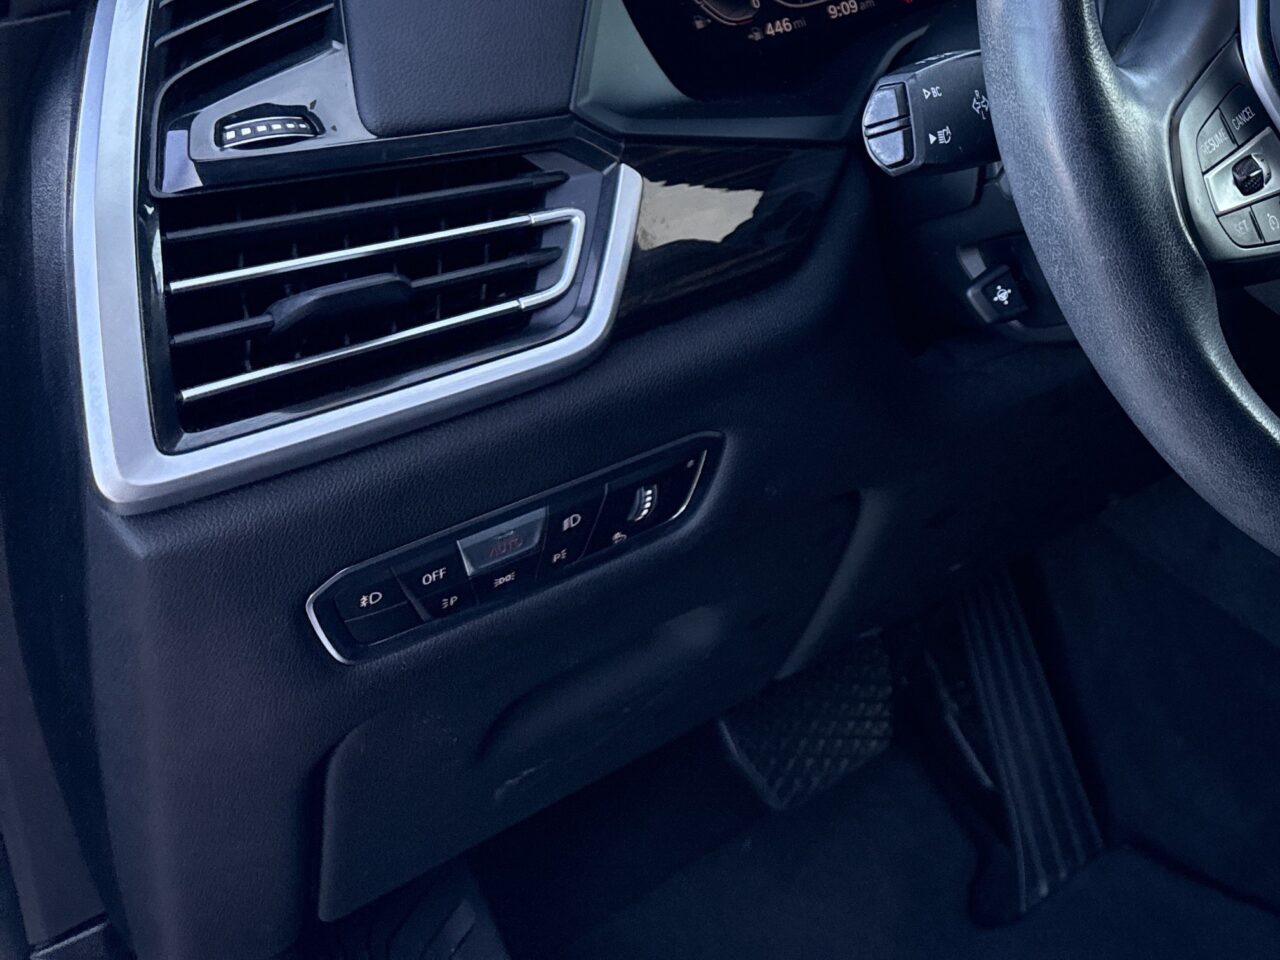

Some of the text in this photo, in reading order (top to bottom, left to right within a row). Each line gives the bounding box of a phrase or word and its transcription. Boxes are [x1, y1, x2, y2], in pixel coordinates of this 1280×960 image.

[827, 0, 859, 20] 9:09
[765, 17, 793, 37] 446
[1231, 105, 1256, 131] CANCEL
[1201, 127, 1229, 154] RESUME
[1234, 219, 1249, 238] SET
[421, 567, 447, 586] OFF
